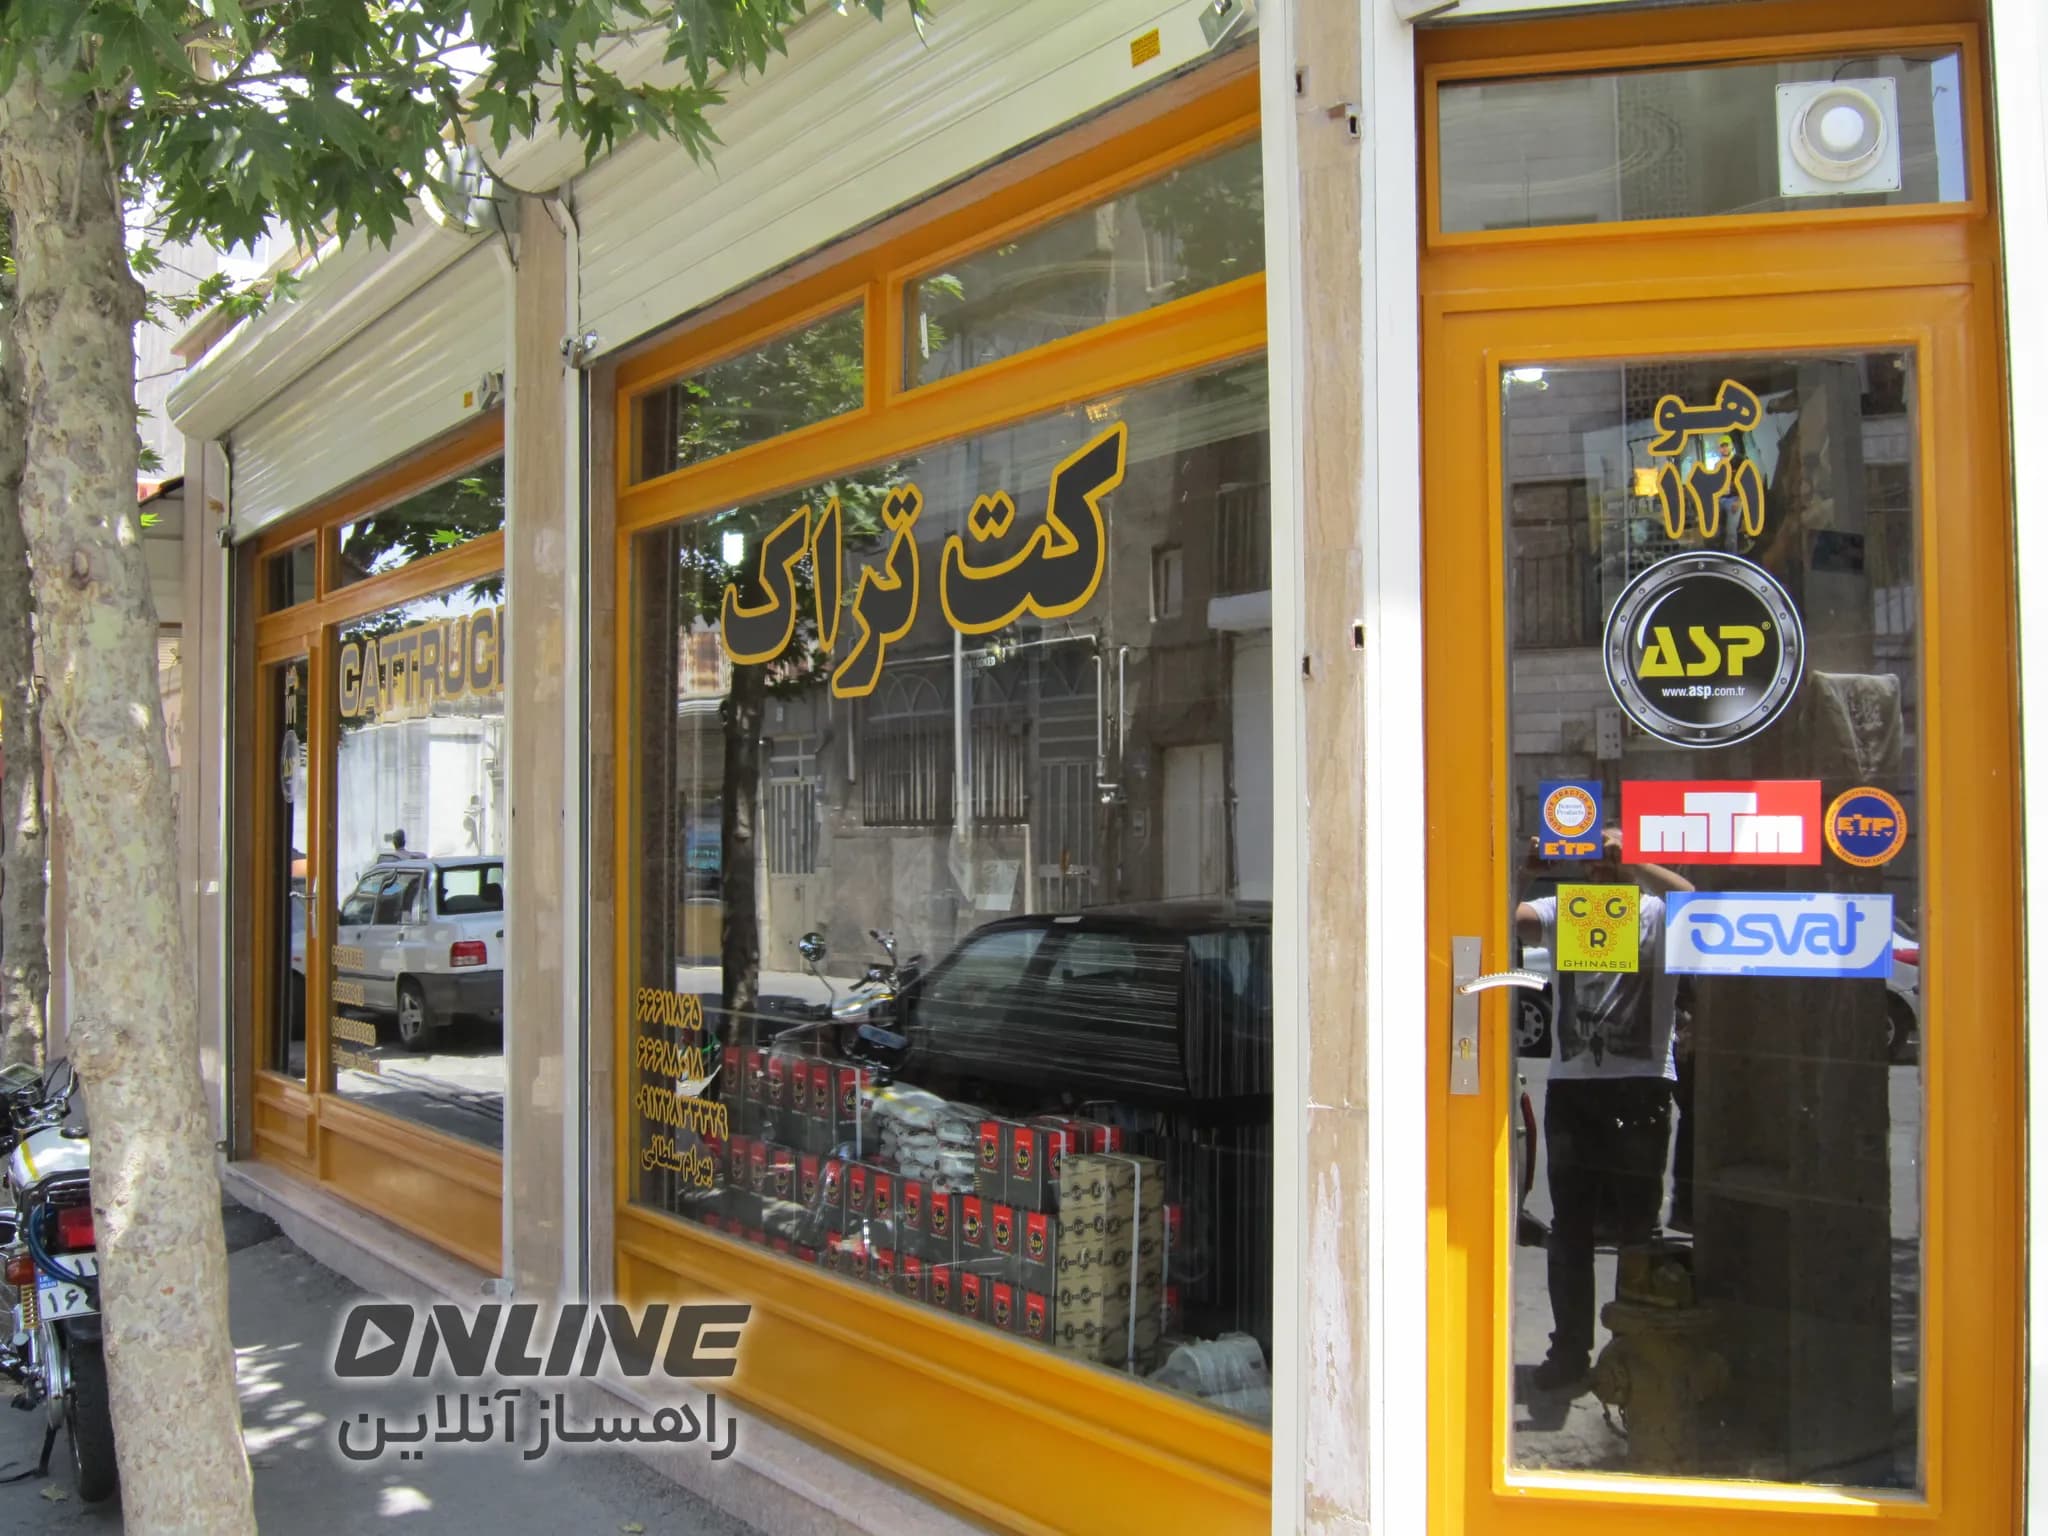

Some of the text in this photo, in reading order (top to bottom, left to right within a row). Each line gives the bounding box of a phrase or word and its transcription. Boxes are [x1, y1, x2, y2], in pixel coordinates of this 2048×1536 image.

[1648, 379, 1761, 456] هو
[1656, 458, 1766, 539] ۱۲۱
[721, 420, 1128, 699] کت تراک
[339, 604, 504, 720] CATTRUC
[1637, 624, 1766, 678] ASP
[1661, 685, 1746, 699] www.asp.com.tr
[1544, 839, 1597, 856] ETP
[1563, 959, 1632, 969] GHINASSI
[636, 987, 703, 1031] ۶۶۶۱۱۸۶۵
[636, 1035, 704, 1083] ۶۶۶۸۸۰۱۸
